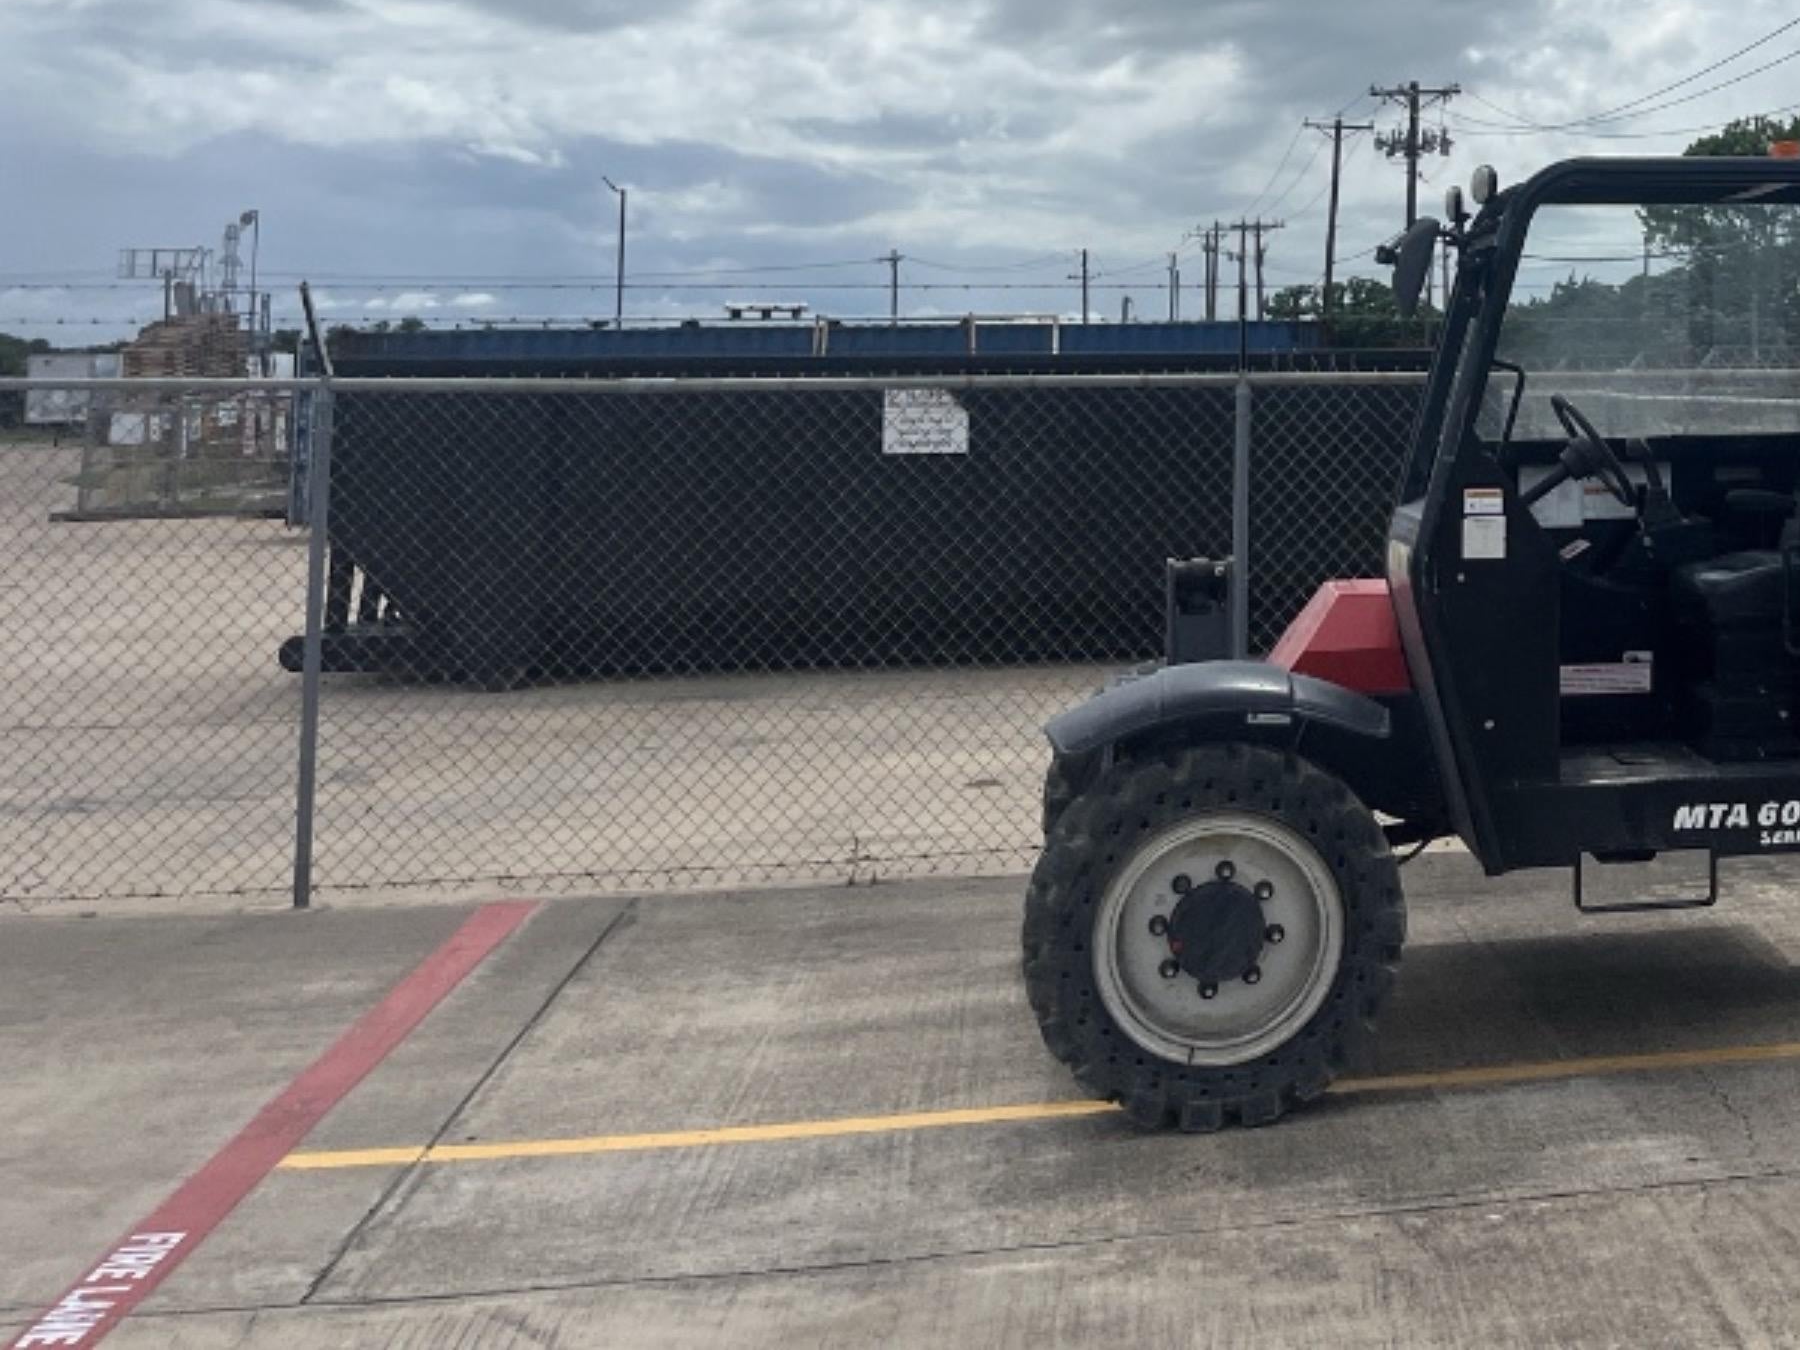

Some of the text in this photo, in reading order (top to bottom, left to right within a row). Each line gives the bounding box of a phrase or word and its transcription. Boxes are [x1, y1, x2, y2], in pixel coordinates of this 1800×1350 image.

[1673, 803, 1749, 831] MTA
[15, 1231, 187, 1348] FIRE LANE
